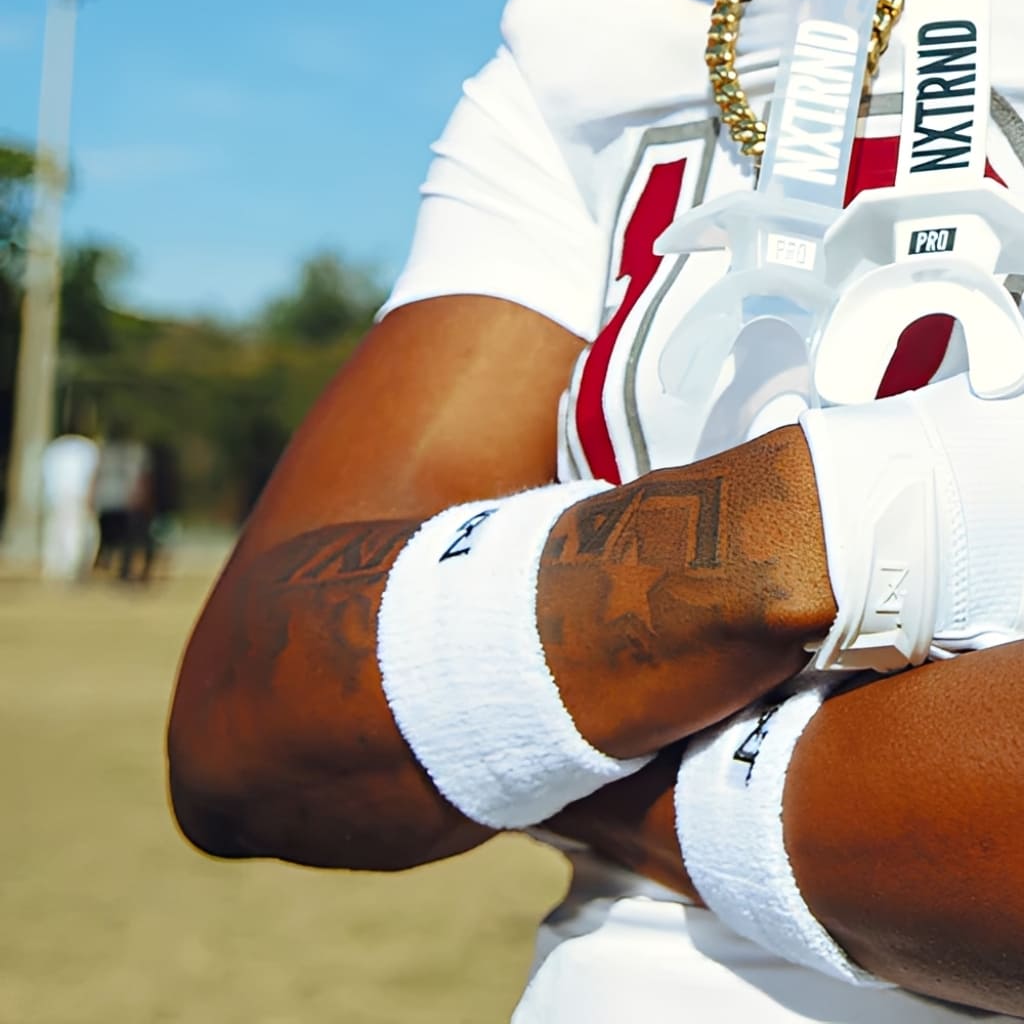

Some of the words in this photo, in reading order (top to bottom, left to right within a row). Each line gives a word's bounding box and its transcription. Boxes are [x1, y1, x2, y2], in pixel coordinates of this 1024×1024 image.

[772, 19, 860, 187] NXTRND
[909, 19, 978, 174] NXTRND
[914, 228, 951, 254] PRO
